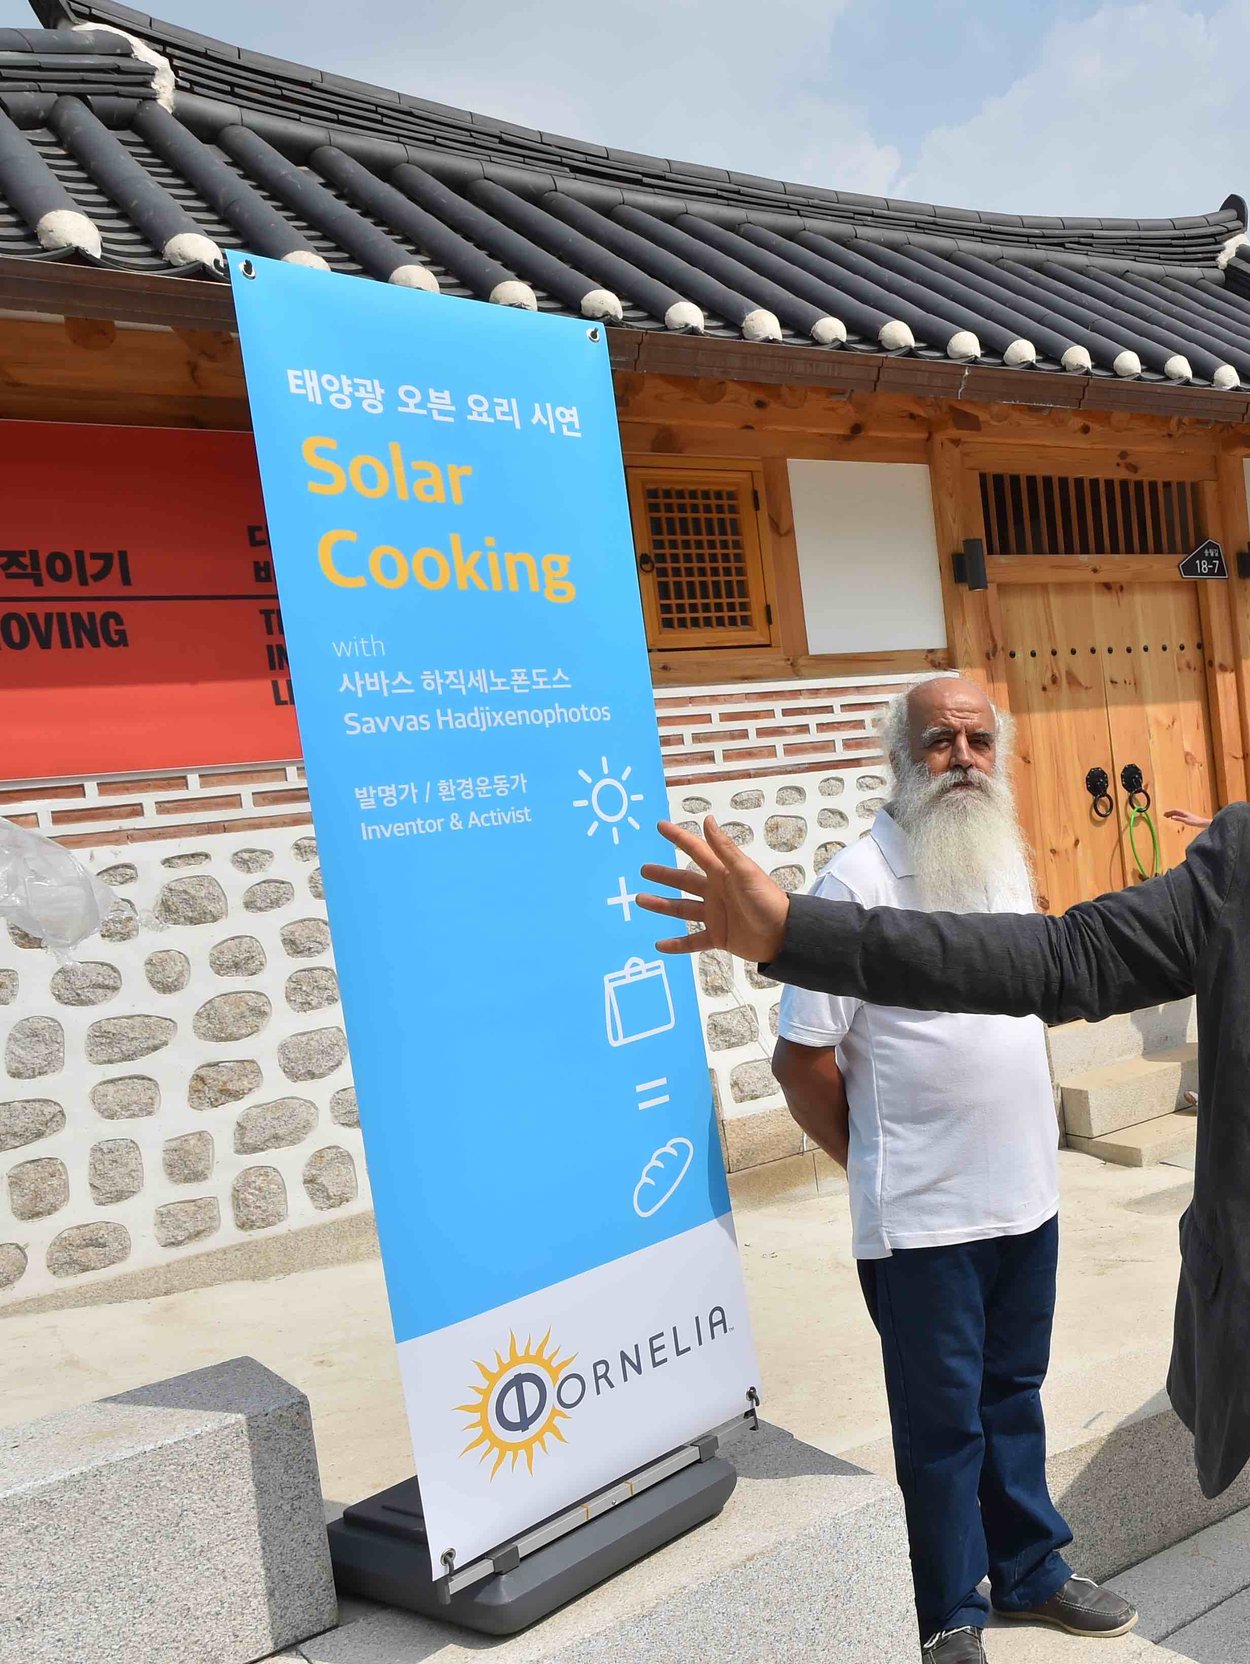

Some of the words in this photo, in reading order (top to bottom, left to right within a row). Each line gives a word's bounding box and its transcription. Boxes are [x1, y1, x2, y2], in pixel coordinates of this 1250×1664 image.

[286, 368, 386, 415] 태양광
[397, 384, 456, 423] 오븐
[466, 393, 521, 430] 요리
[530, 402, 583, 438] 시연
[301, 435, 473, 505] Solar
[317, 529, 577, 604] Cooking
[1195, 560, 1220, 574] 18-7
[0, 610, 129, 650] OVING
[331, 634, 386, 658] with
[338, 670, 416, 698] 사바스
[420, 667, 573, 695] 하직세노폰도스
[343, 710, 431, 736] Savvas
[436, 702, 612, 733] Hadjixenophotos
[354, 780, 419, 811] 발명가
[424, 782, 432, 803] /
[436, 772, 529, 804] 환경운동가
[360, 815, 445, 841] Inventor
[449, 811, 464, 831] &
[467, 805, 533, 829] Activist
